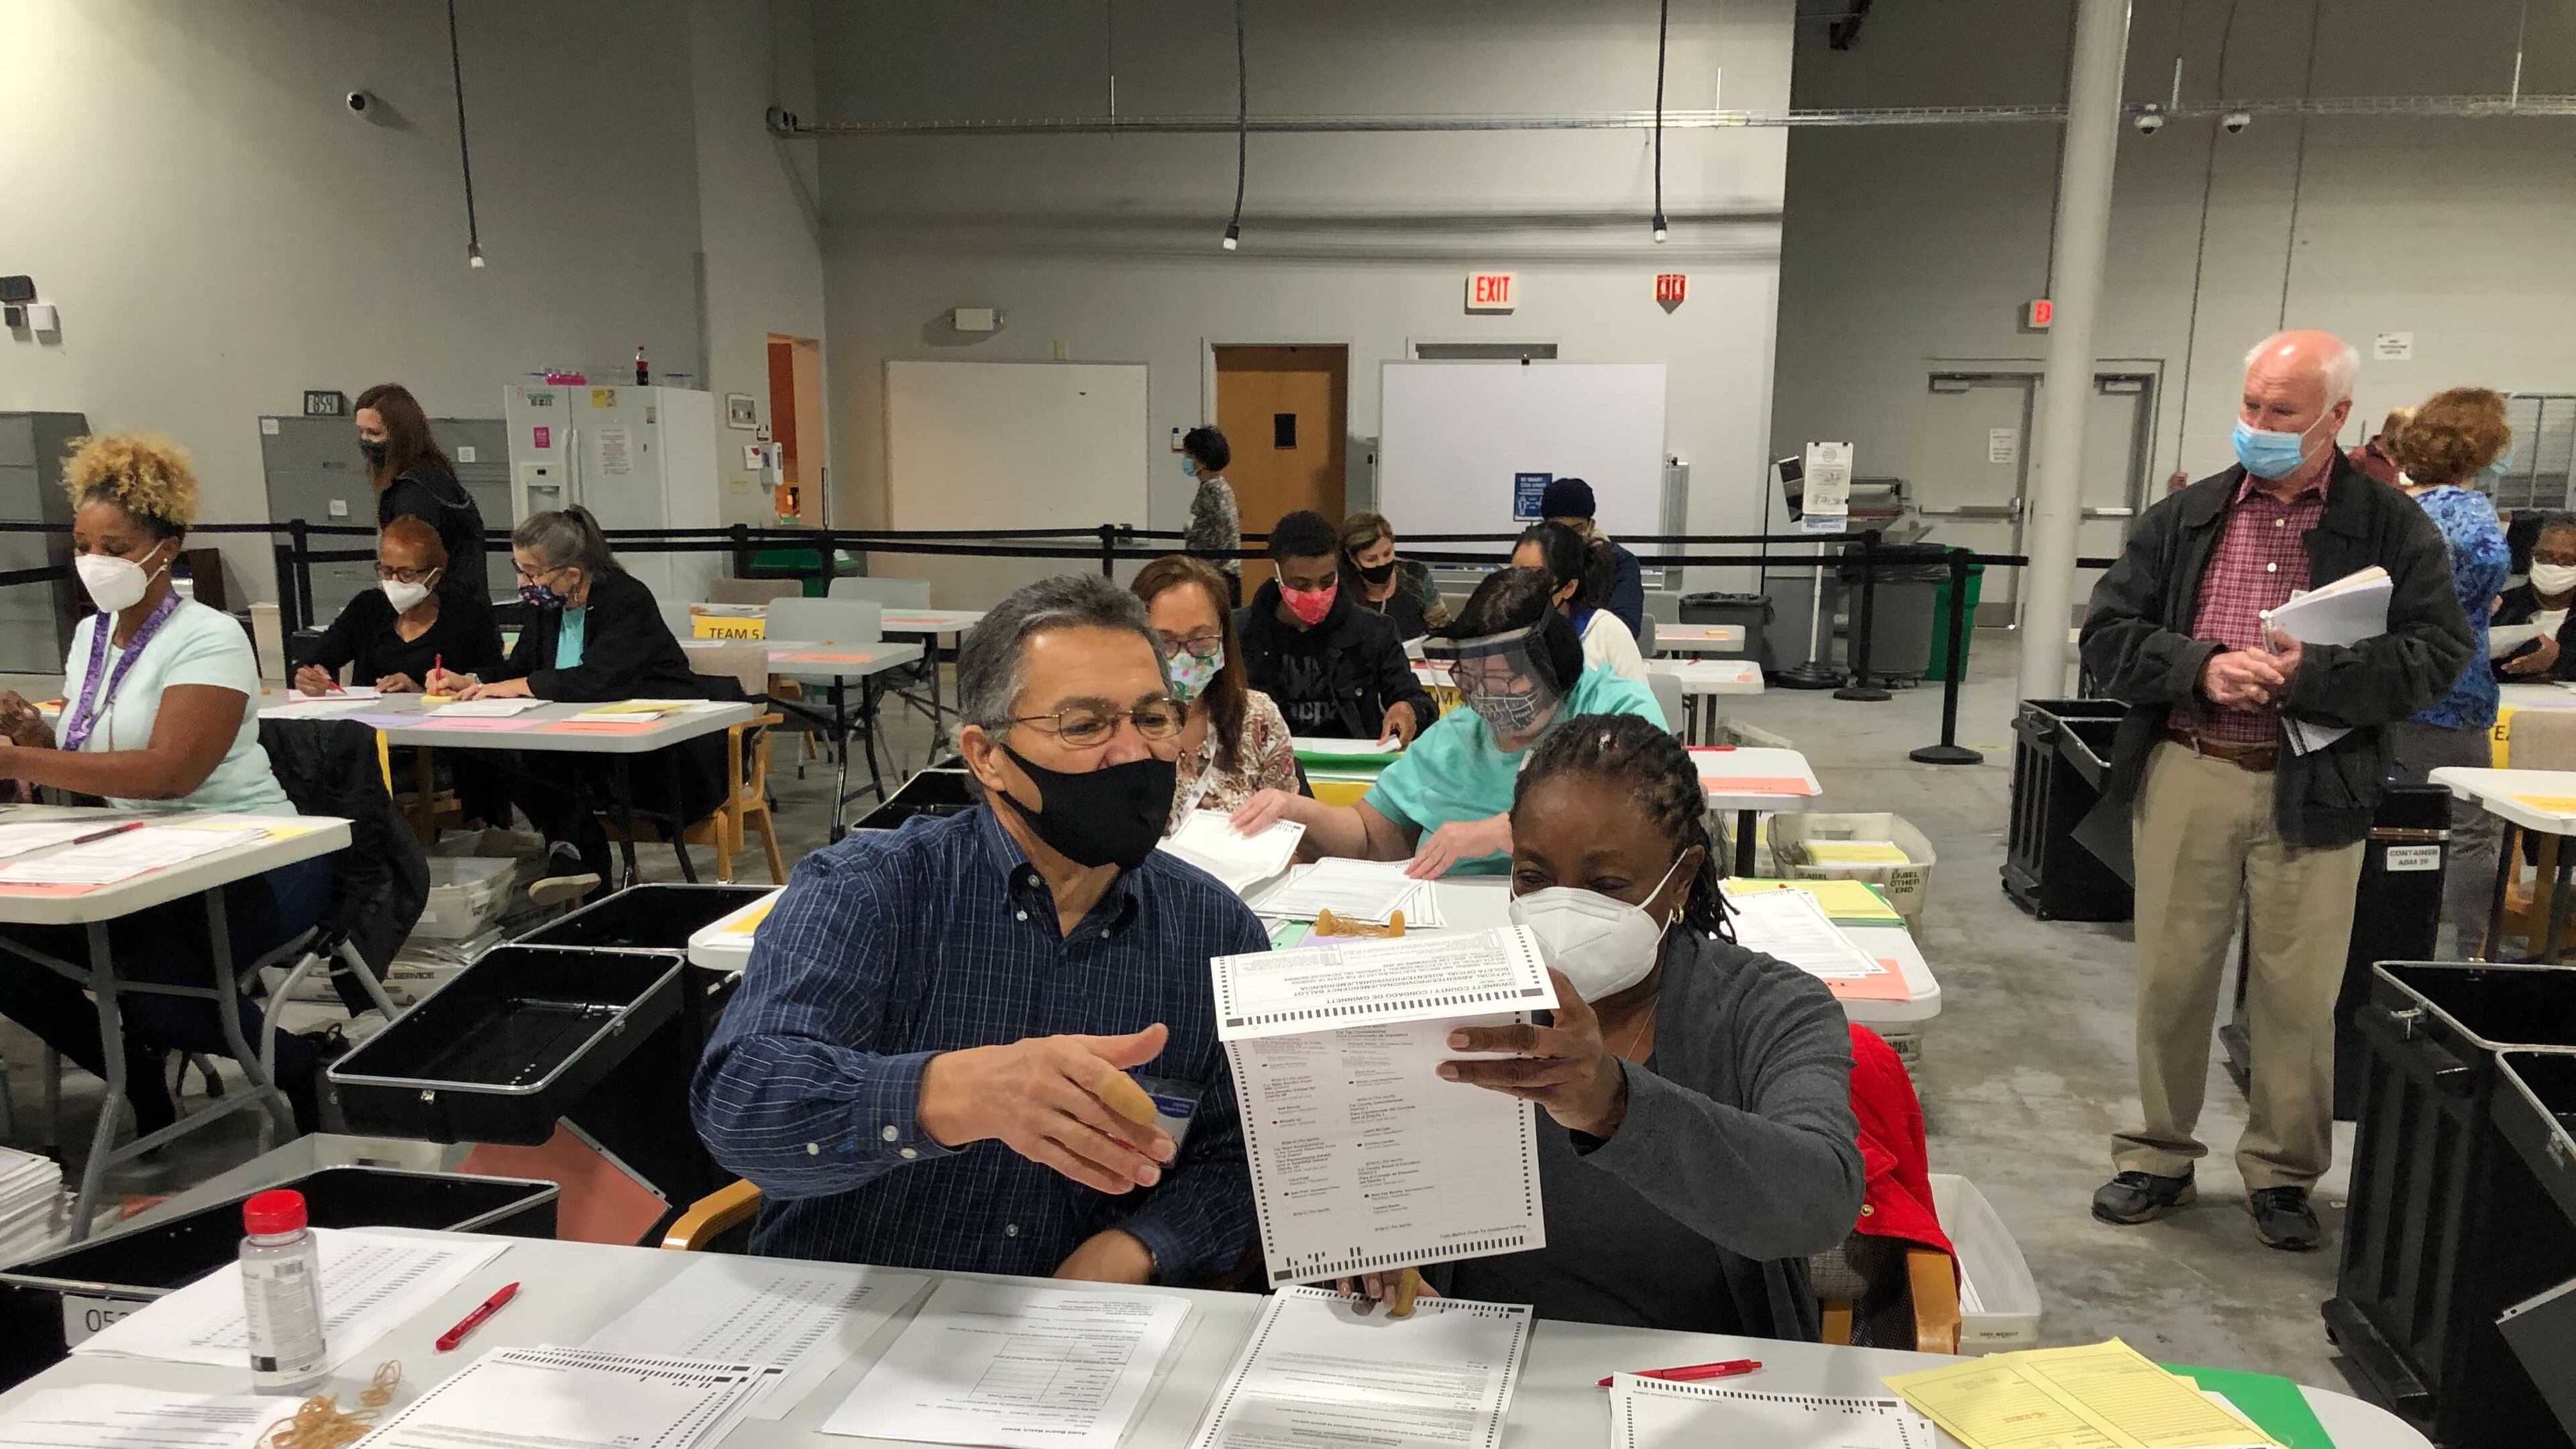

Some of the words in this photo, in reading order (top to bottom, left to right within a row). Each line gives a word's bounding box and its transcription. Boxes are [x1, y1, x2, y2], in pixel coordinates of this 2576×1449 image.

[1477, 276, 1510, 302] EXIT
[709, 628, 747, 639] TEAM
[752, 629, 759, 639] 5
[1892, 871, 1919, 879] LABEL
[1890, 879, 1920, 888] OTHER
[1434, 985, 1470, 994] COUNTY
[1471, 981, 1515, 989] GWINNETT
[1384, 989, 1428, 998] CONDADO
[1326, 996, 1369, 1004] GWINNETT
[85, 1309, 130, 1332] 05
